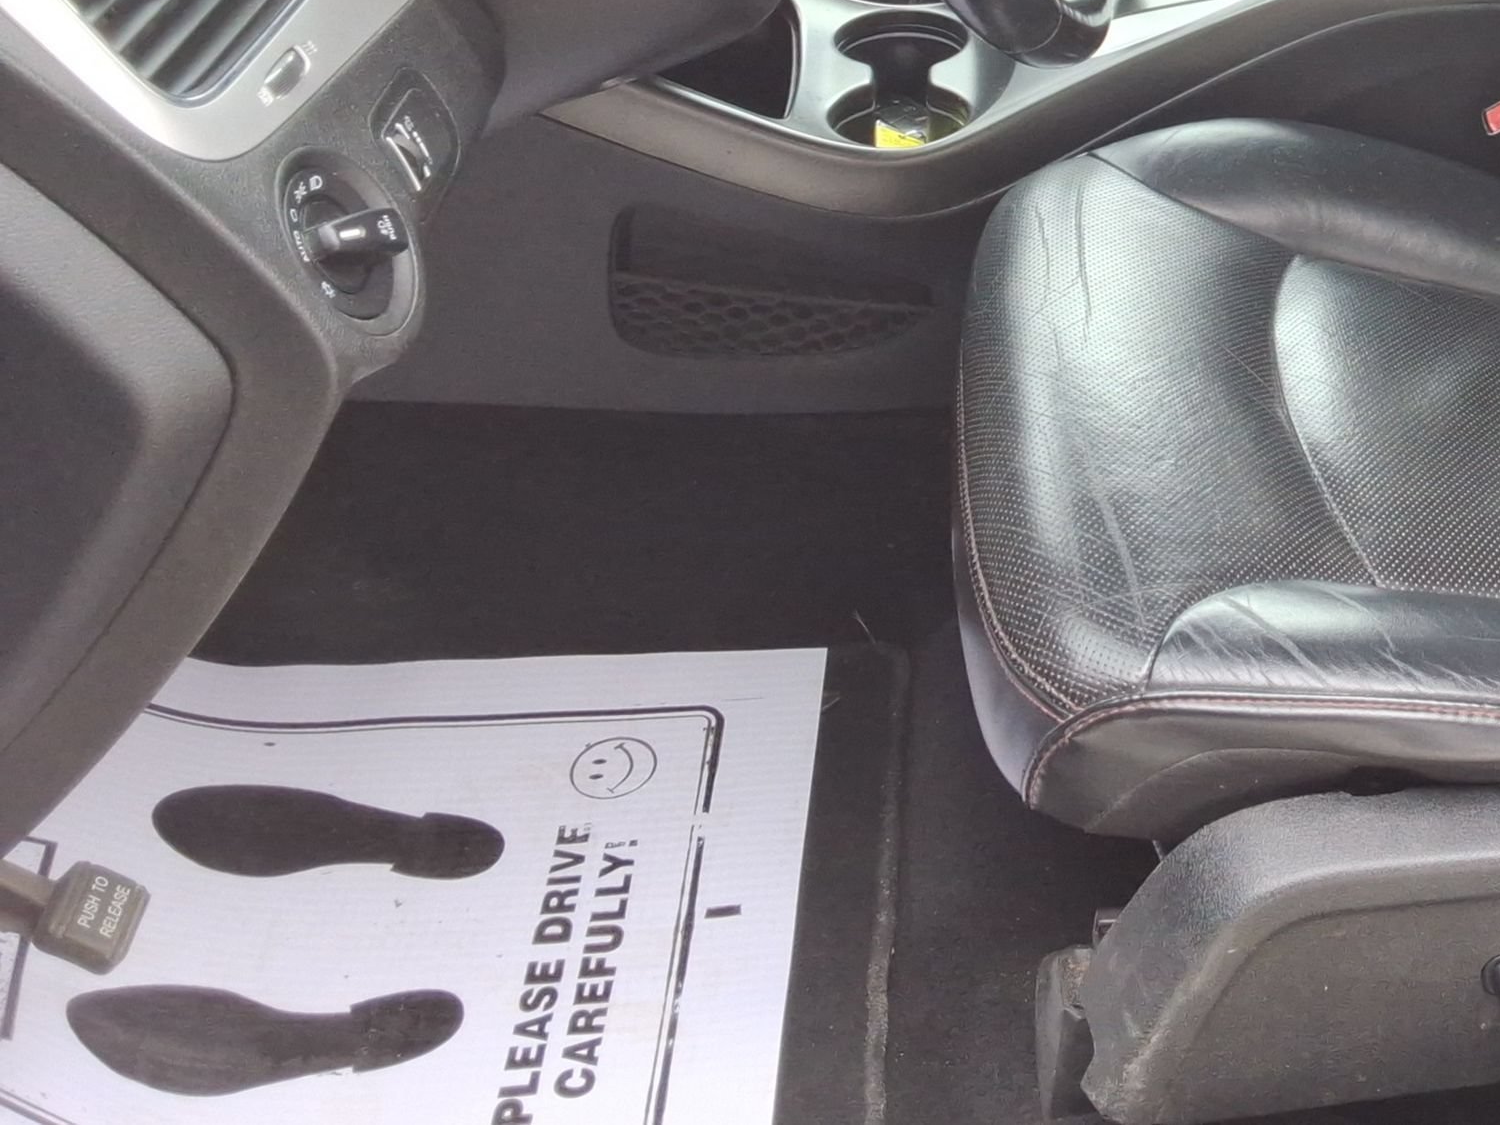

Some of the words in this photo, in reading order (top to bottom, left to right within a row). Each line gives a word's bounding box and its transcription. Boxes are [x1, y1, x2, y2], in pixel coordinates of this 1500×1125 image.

[77, 895, 101, 929] PUSH
[91, 876, 108, 892] TO
[99, 884, 131, 938] RELEASE
[490, 959, 566, 1125] PLEASE
[531, 824, 592, 945] DRIVE
[553, 839, 639, 1099] CAREFULLY!
